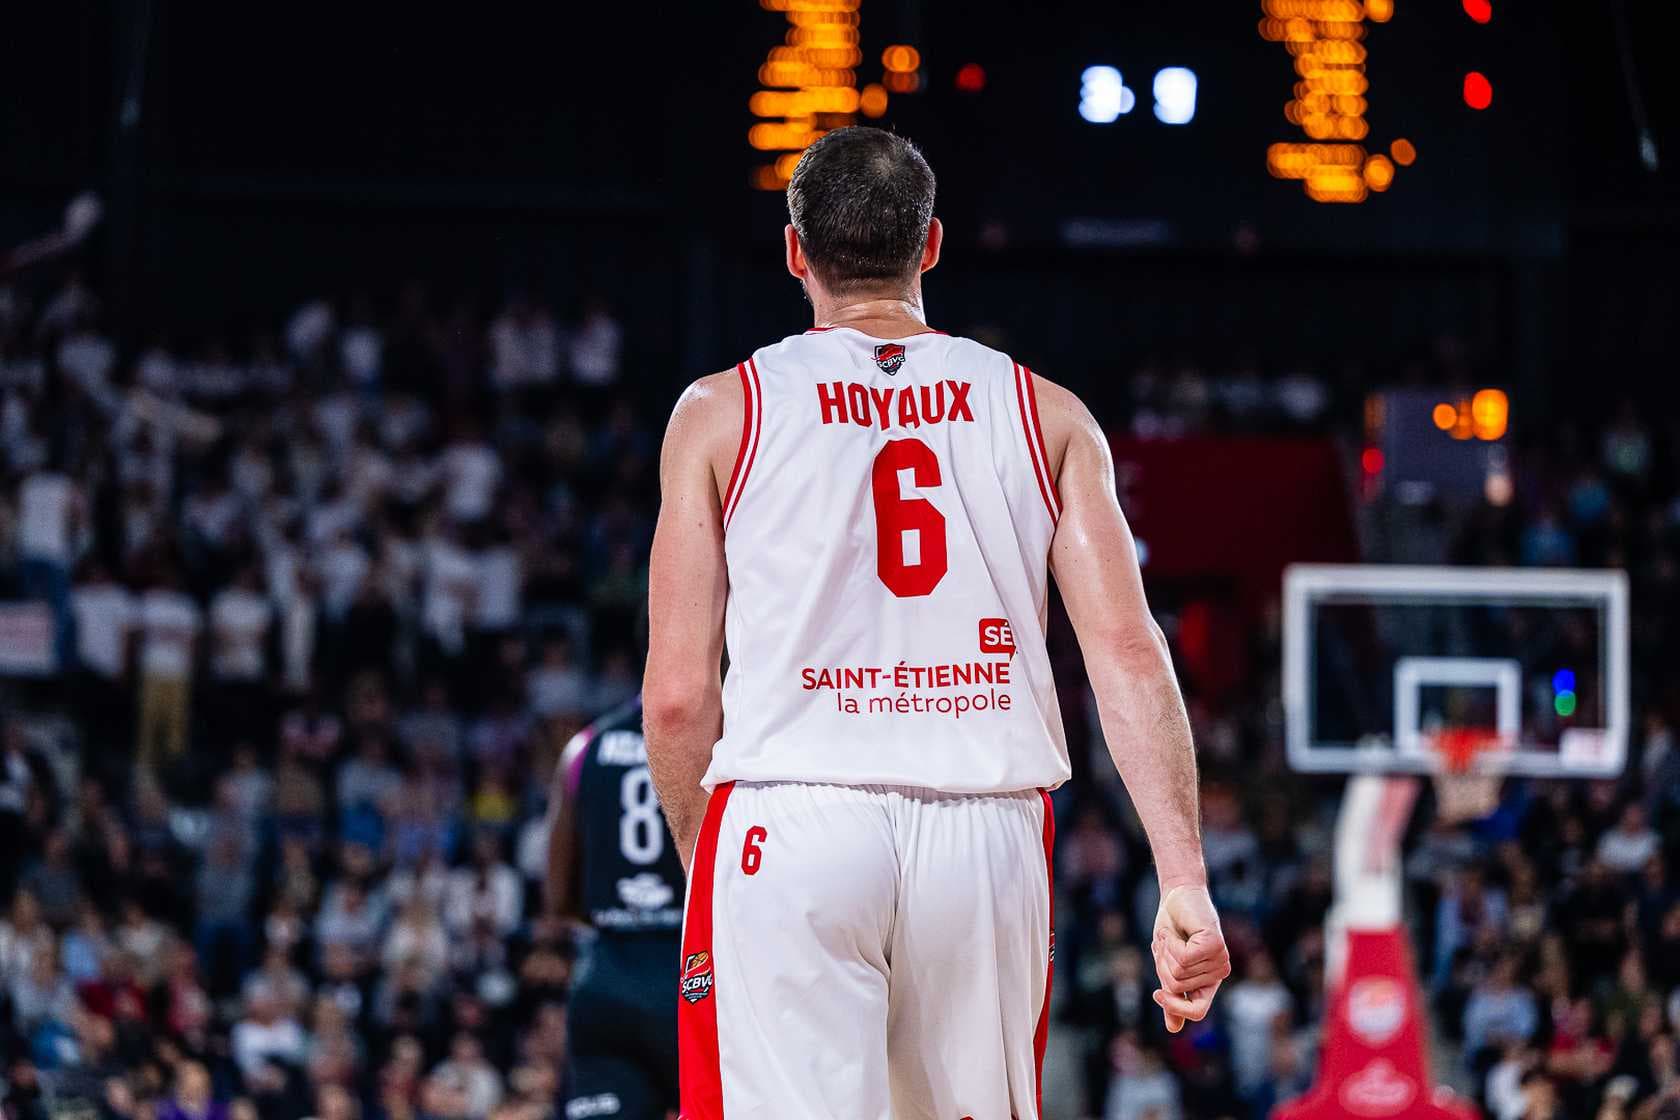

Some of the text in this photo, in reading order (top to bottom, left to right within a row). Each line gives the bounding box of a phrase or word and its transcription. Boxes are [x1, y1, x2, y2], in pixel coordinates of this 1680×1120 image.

[816, 379, 975, 431] HOYAUX
[871, 438, 948, 598] 6
[984, 621, 1013, 646] SÉ
[801, 660, 1010, 690] SAINT-ÉTIENNE
[837, 687, 1011, 719] la métropole
[619, 767, 664, 865] 8
[741, 825, 768, 876] 6
